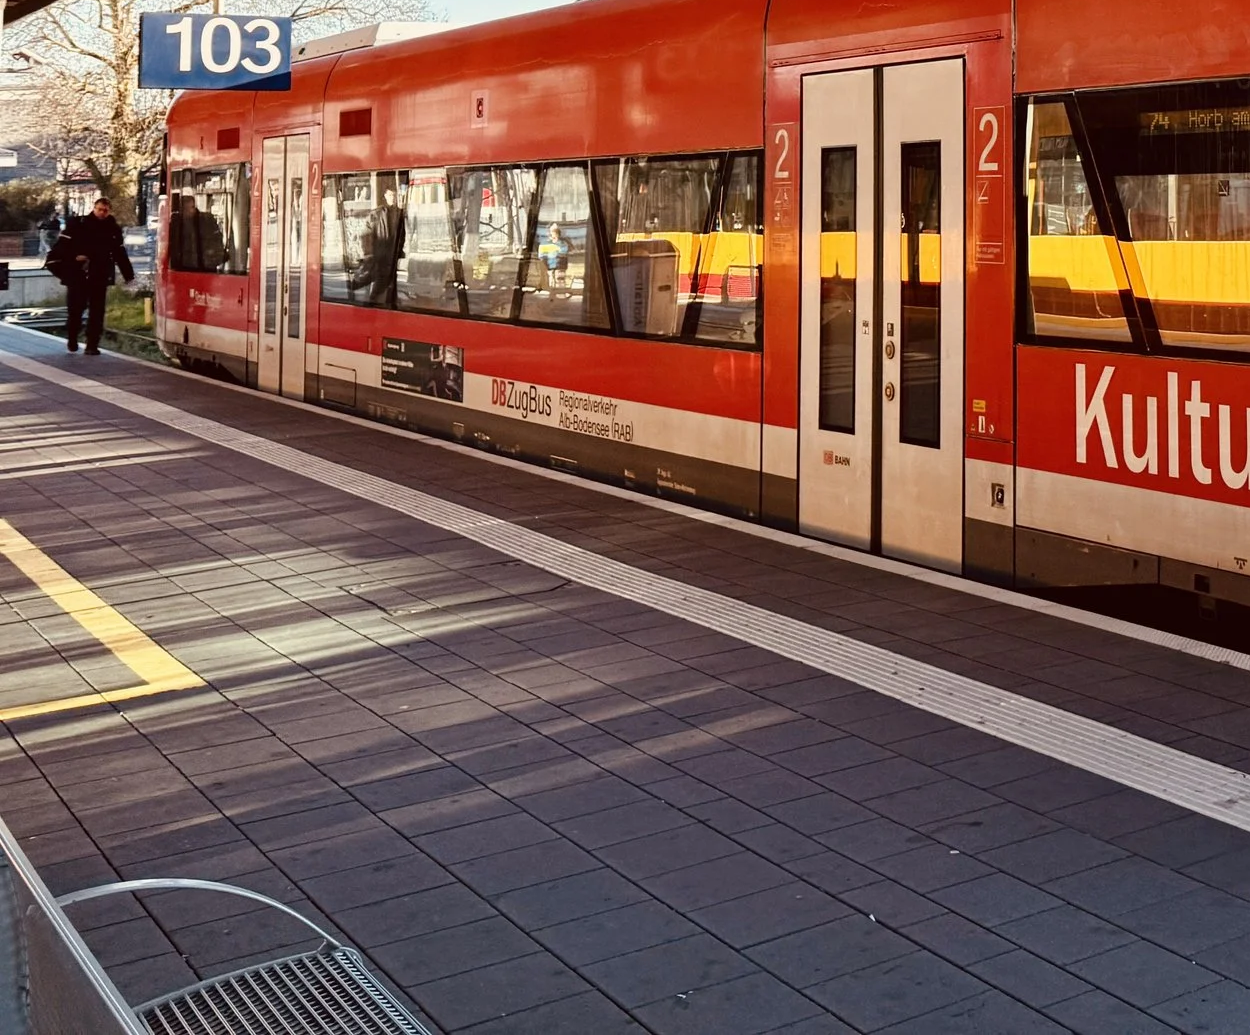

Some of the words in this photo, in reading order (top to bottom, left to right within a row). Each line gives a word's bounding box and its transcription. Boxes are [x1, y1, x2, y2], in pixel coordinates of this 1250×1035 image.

[166, 17, 282, 74] 103
[1188, 109, 1223, 128] Horb
[1231, 111, 1250, 125] am
[774, 129, 789, 178] 2
[978, 112, 999, 171] 2
[253, 167, 260, 196] 2
[311, 163, 319, 195] 2
[559, 390, 618, 417] Regionalverkehr
[559, 412, 610, 438] Alb-Bodensee
[612, 418, 634, 442] (RAB)
